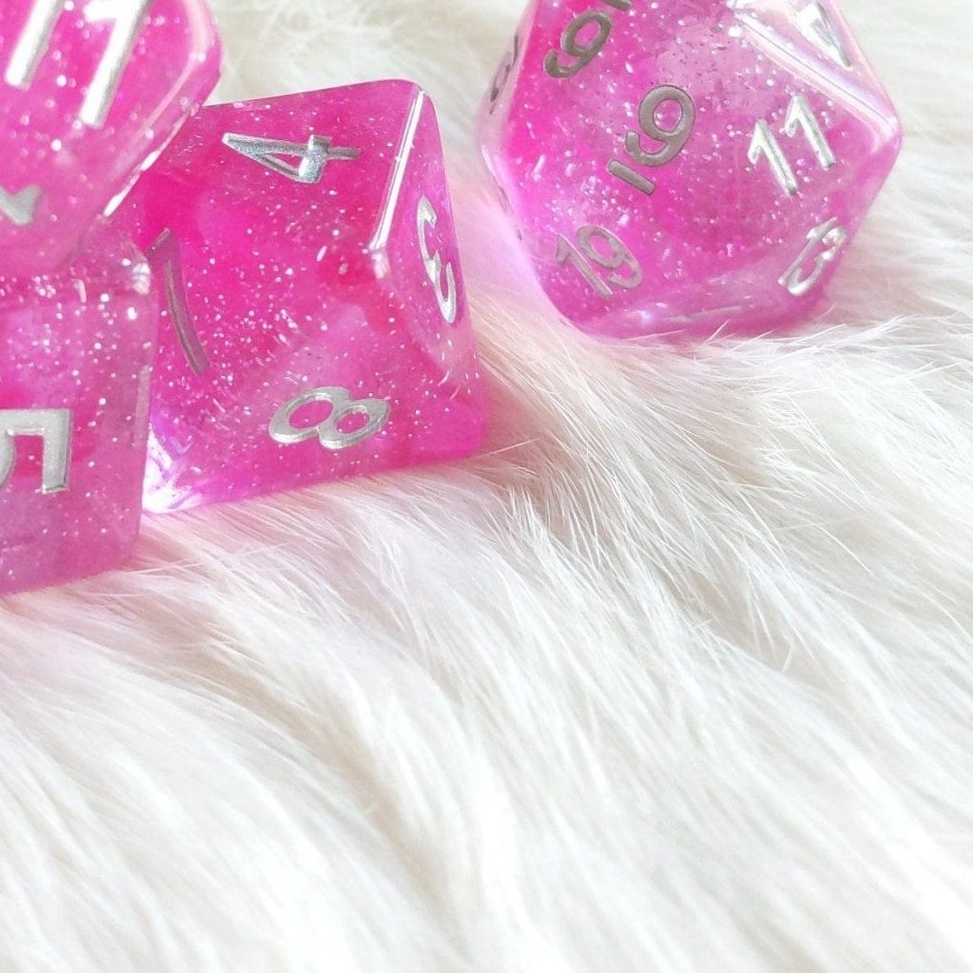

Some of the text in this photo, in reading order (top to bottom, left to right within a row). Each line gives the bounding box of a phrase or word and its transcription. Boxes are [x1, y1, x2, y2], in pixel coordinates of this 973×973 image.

[221, 132, 361, 183] 4
[746, 92, 837, 197] 11
[555, 225, 643, 298] 19
[268, 385, 391, 450] 8
